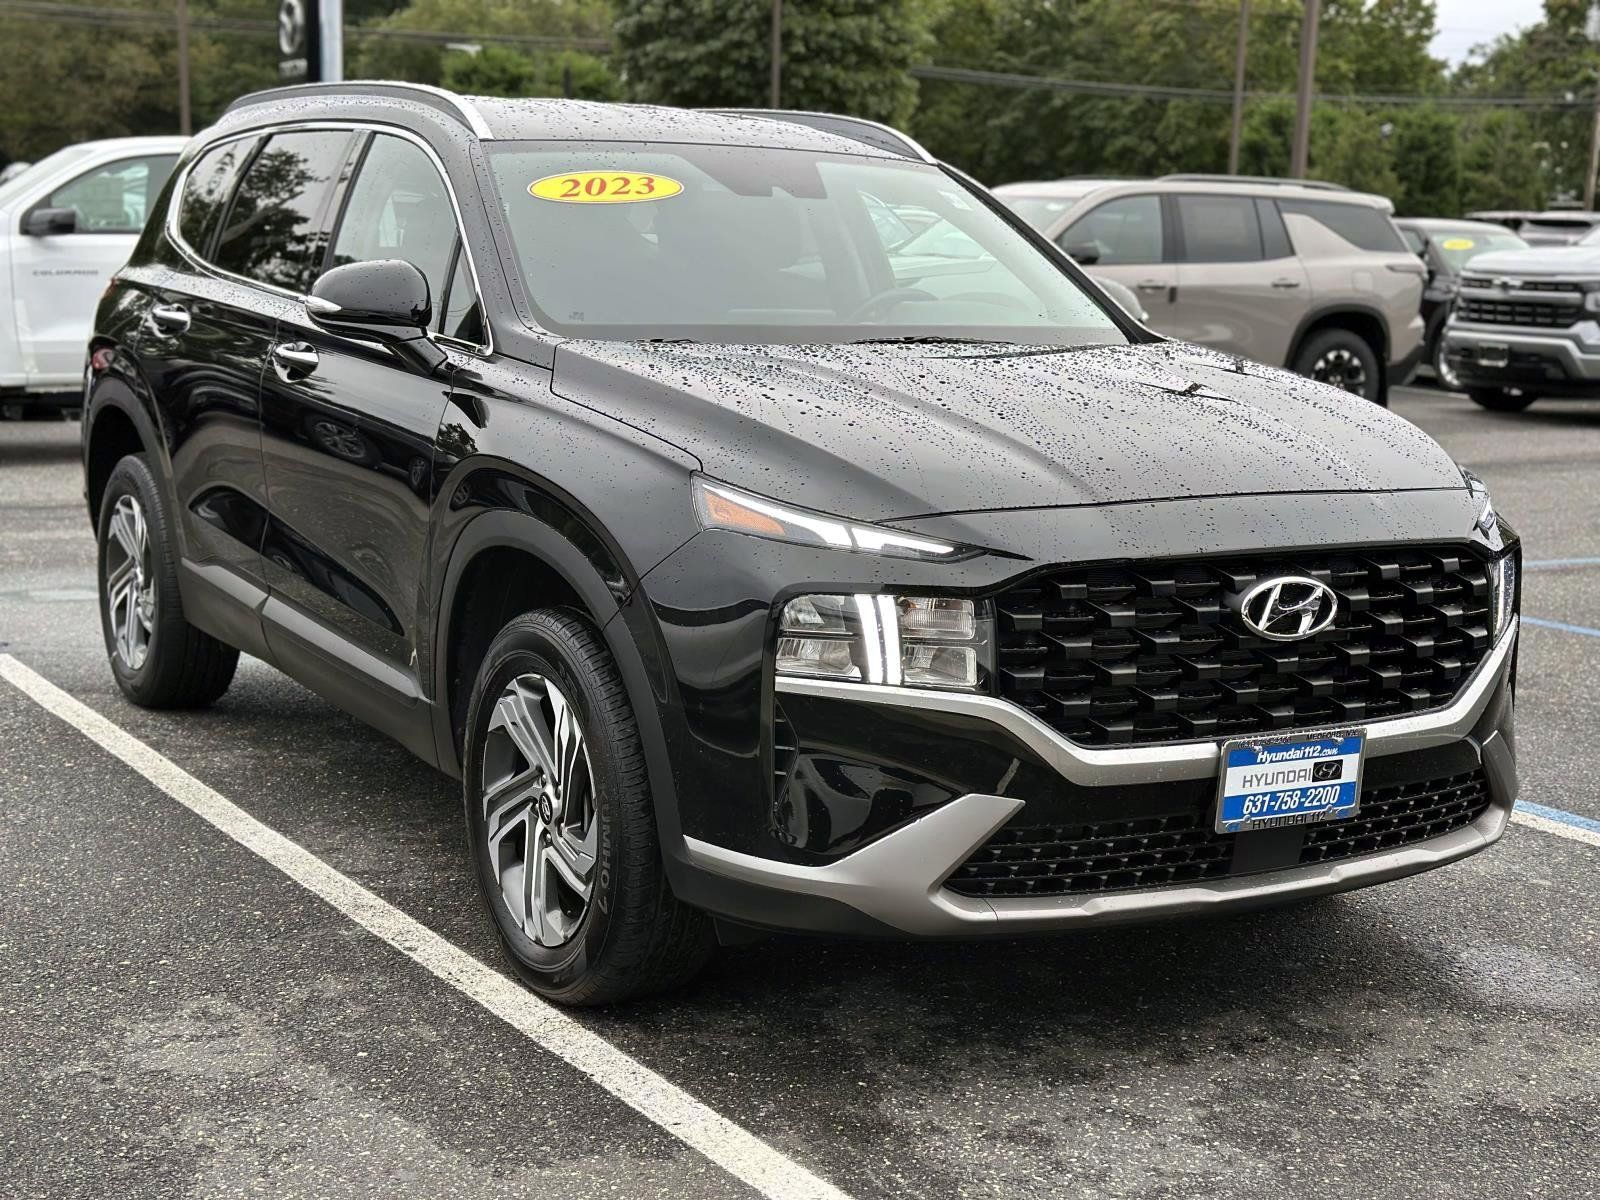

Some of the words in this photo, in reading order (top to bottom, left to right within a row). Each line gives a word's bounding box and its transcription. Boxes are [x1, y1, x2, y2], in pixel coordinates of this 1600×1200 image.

[559, 176, 655, 198] 2023
[1242, 767, 1311, 788] HYUNDAI
[1242, 785, 1340, 815] 631-758-2200
[1252, 812, 1307, 830] HYUNDAI
